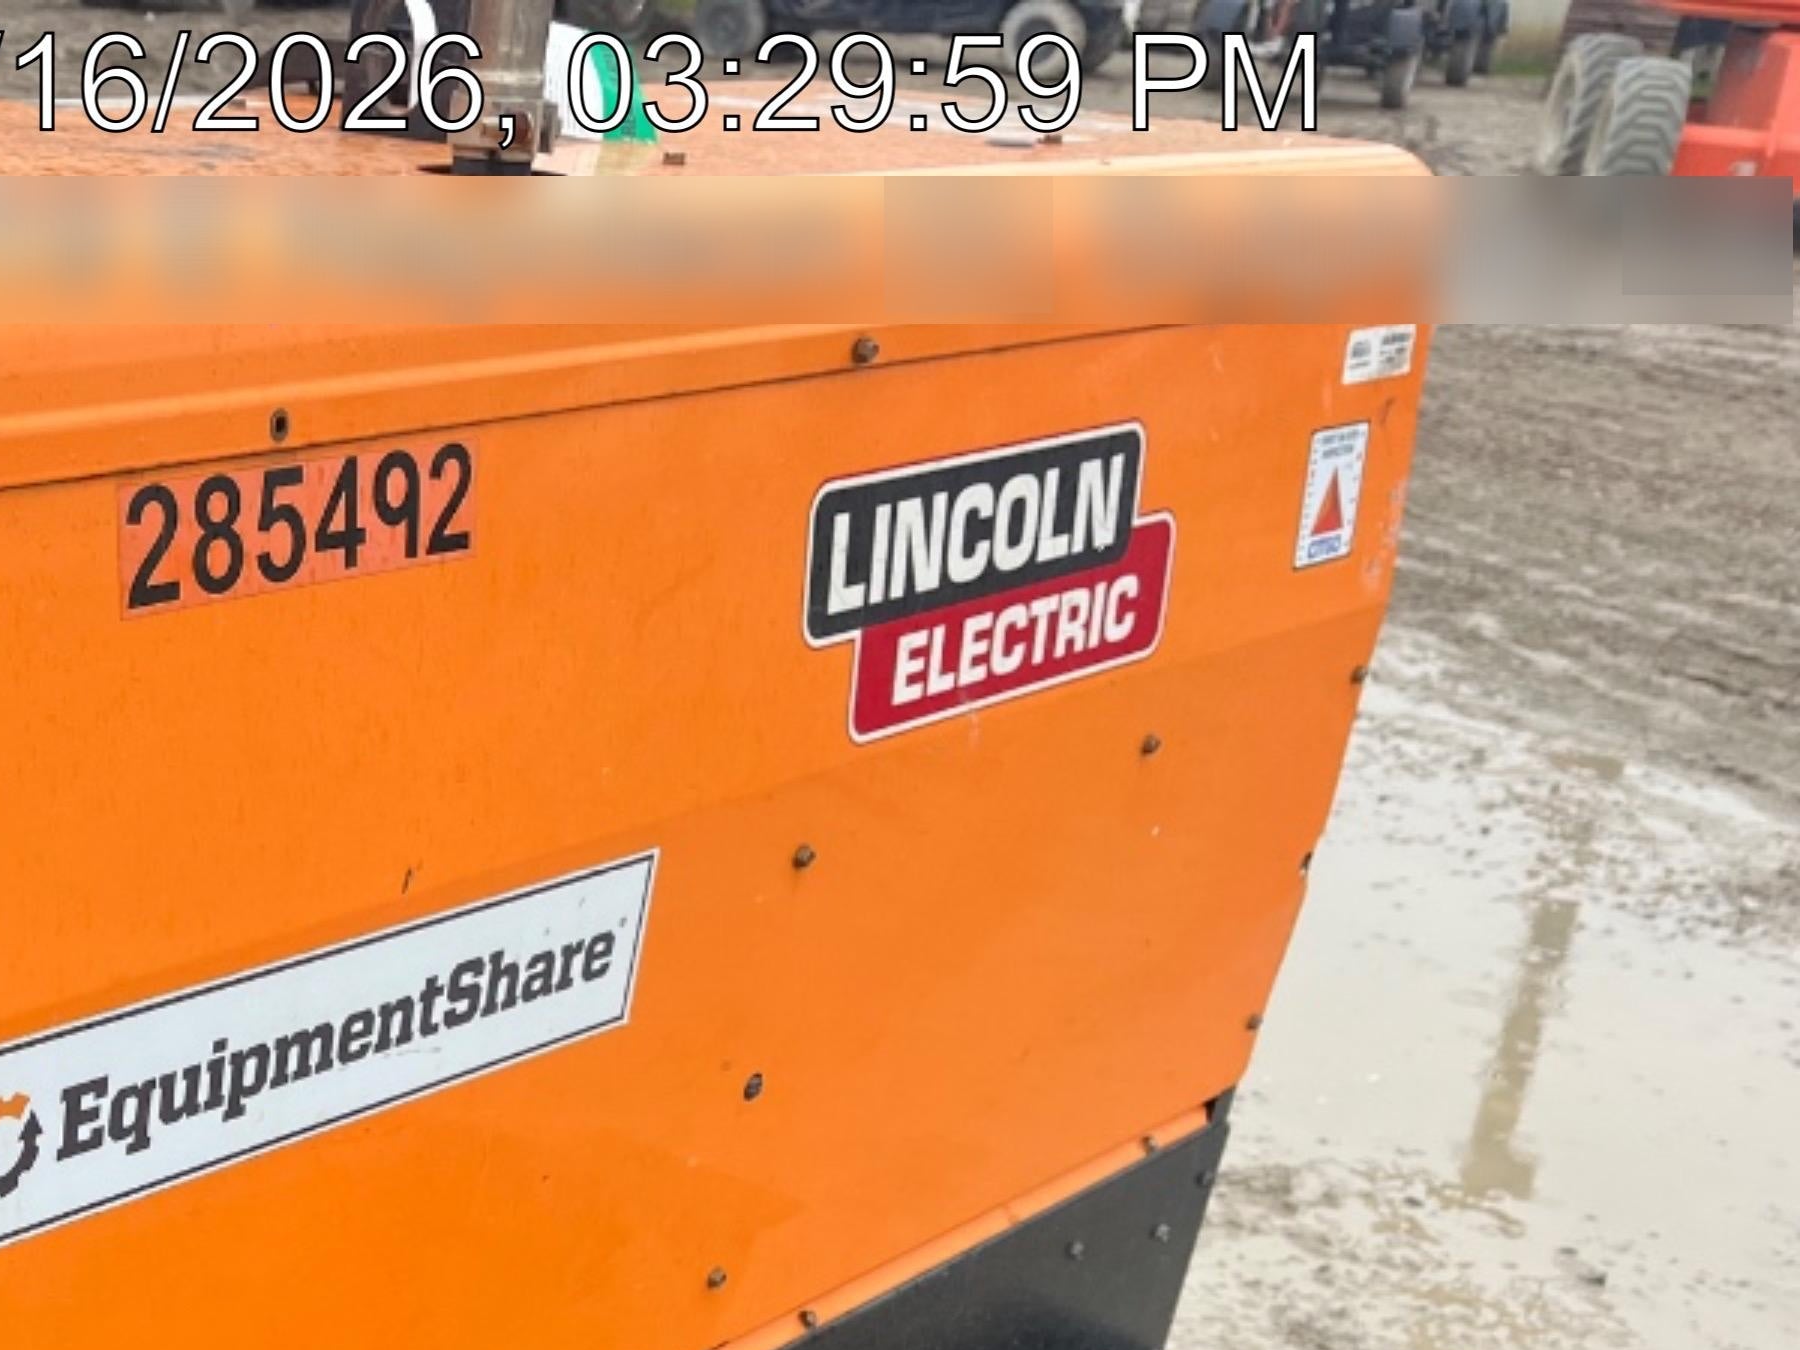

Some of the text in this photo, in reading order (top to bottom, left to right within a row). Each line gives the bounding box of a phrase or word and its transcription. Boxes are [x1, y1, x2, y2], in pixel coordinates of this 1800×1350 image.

[125, 443, 473, 610] 285492
[826, 452, 1126, 616] LINCOLN
[890, 574, 1140, 706] ELECTRIC
[55, 928, 615, 1163] EquipmentShare
